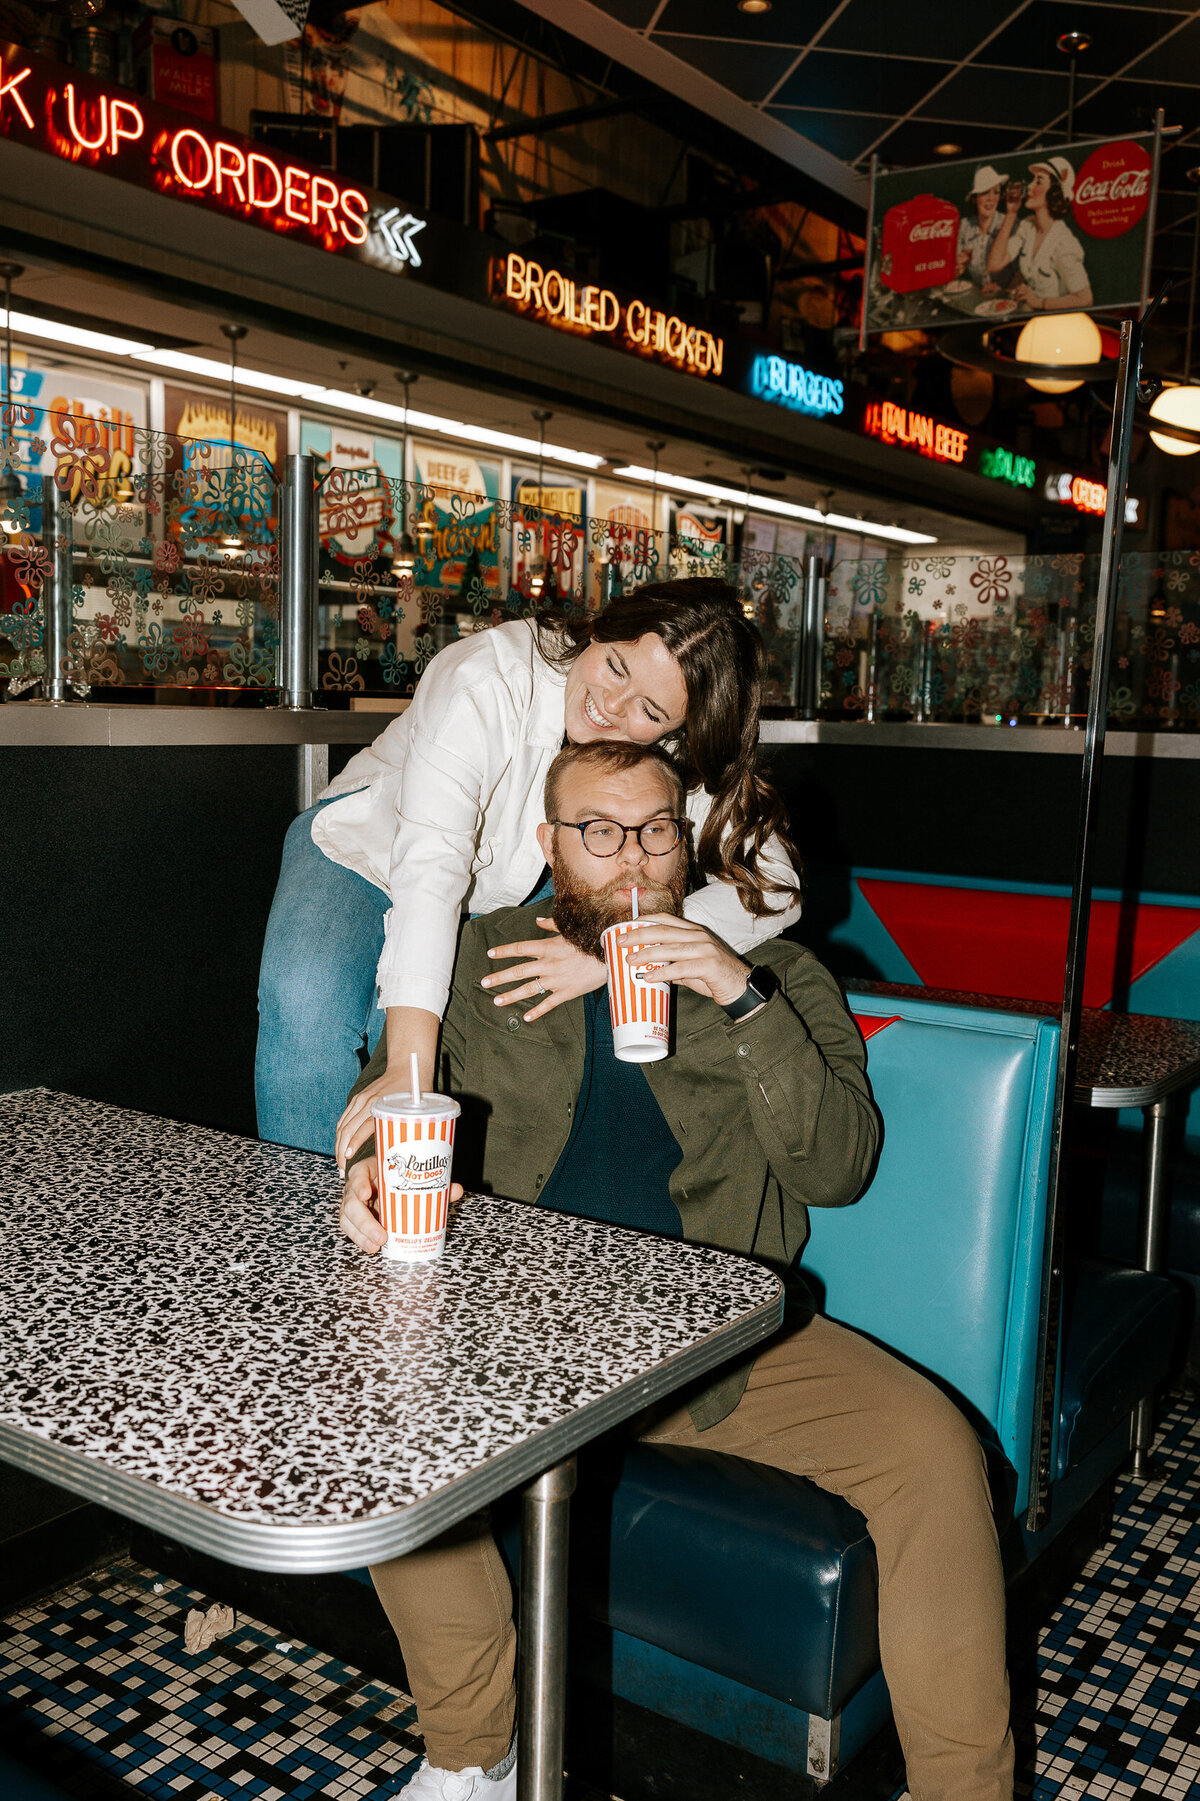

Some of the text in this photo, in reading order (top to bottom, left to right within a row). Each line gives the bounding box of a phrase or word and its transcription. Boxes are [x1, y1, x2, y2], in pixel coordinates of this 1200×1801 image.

[169, 82, 202, 96] MILK
[66, 83, 145, 156] UP
[170, 128, 370, 245] ORDERS
[1102, 158, 1126, 169] Drink
[1075, 169, 1151, 205] Coca-Cola
[909, 218, 955, 243] Coca-Cola
[505, 253, 724, 377] BROILED CHICKEN
[766, 355, 844, 416] BURGERS
[49, 395, 135, 458] Chili
[881, 401, 969, 463] ITALIAN BEEF
[427, 461, 456, 482] BEEF
[405, 1167, 443, 1180] HOT DOGS
[406, 1154, 449, 1172] Portillo's
